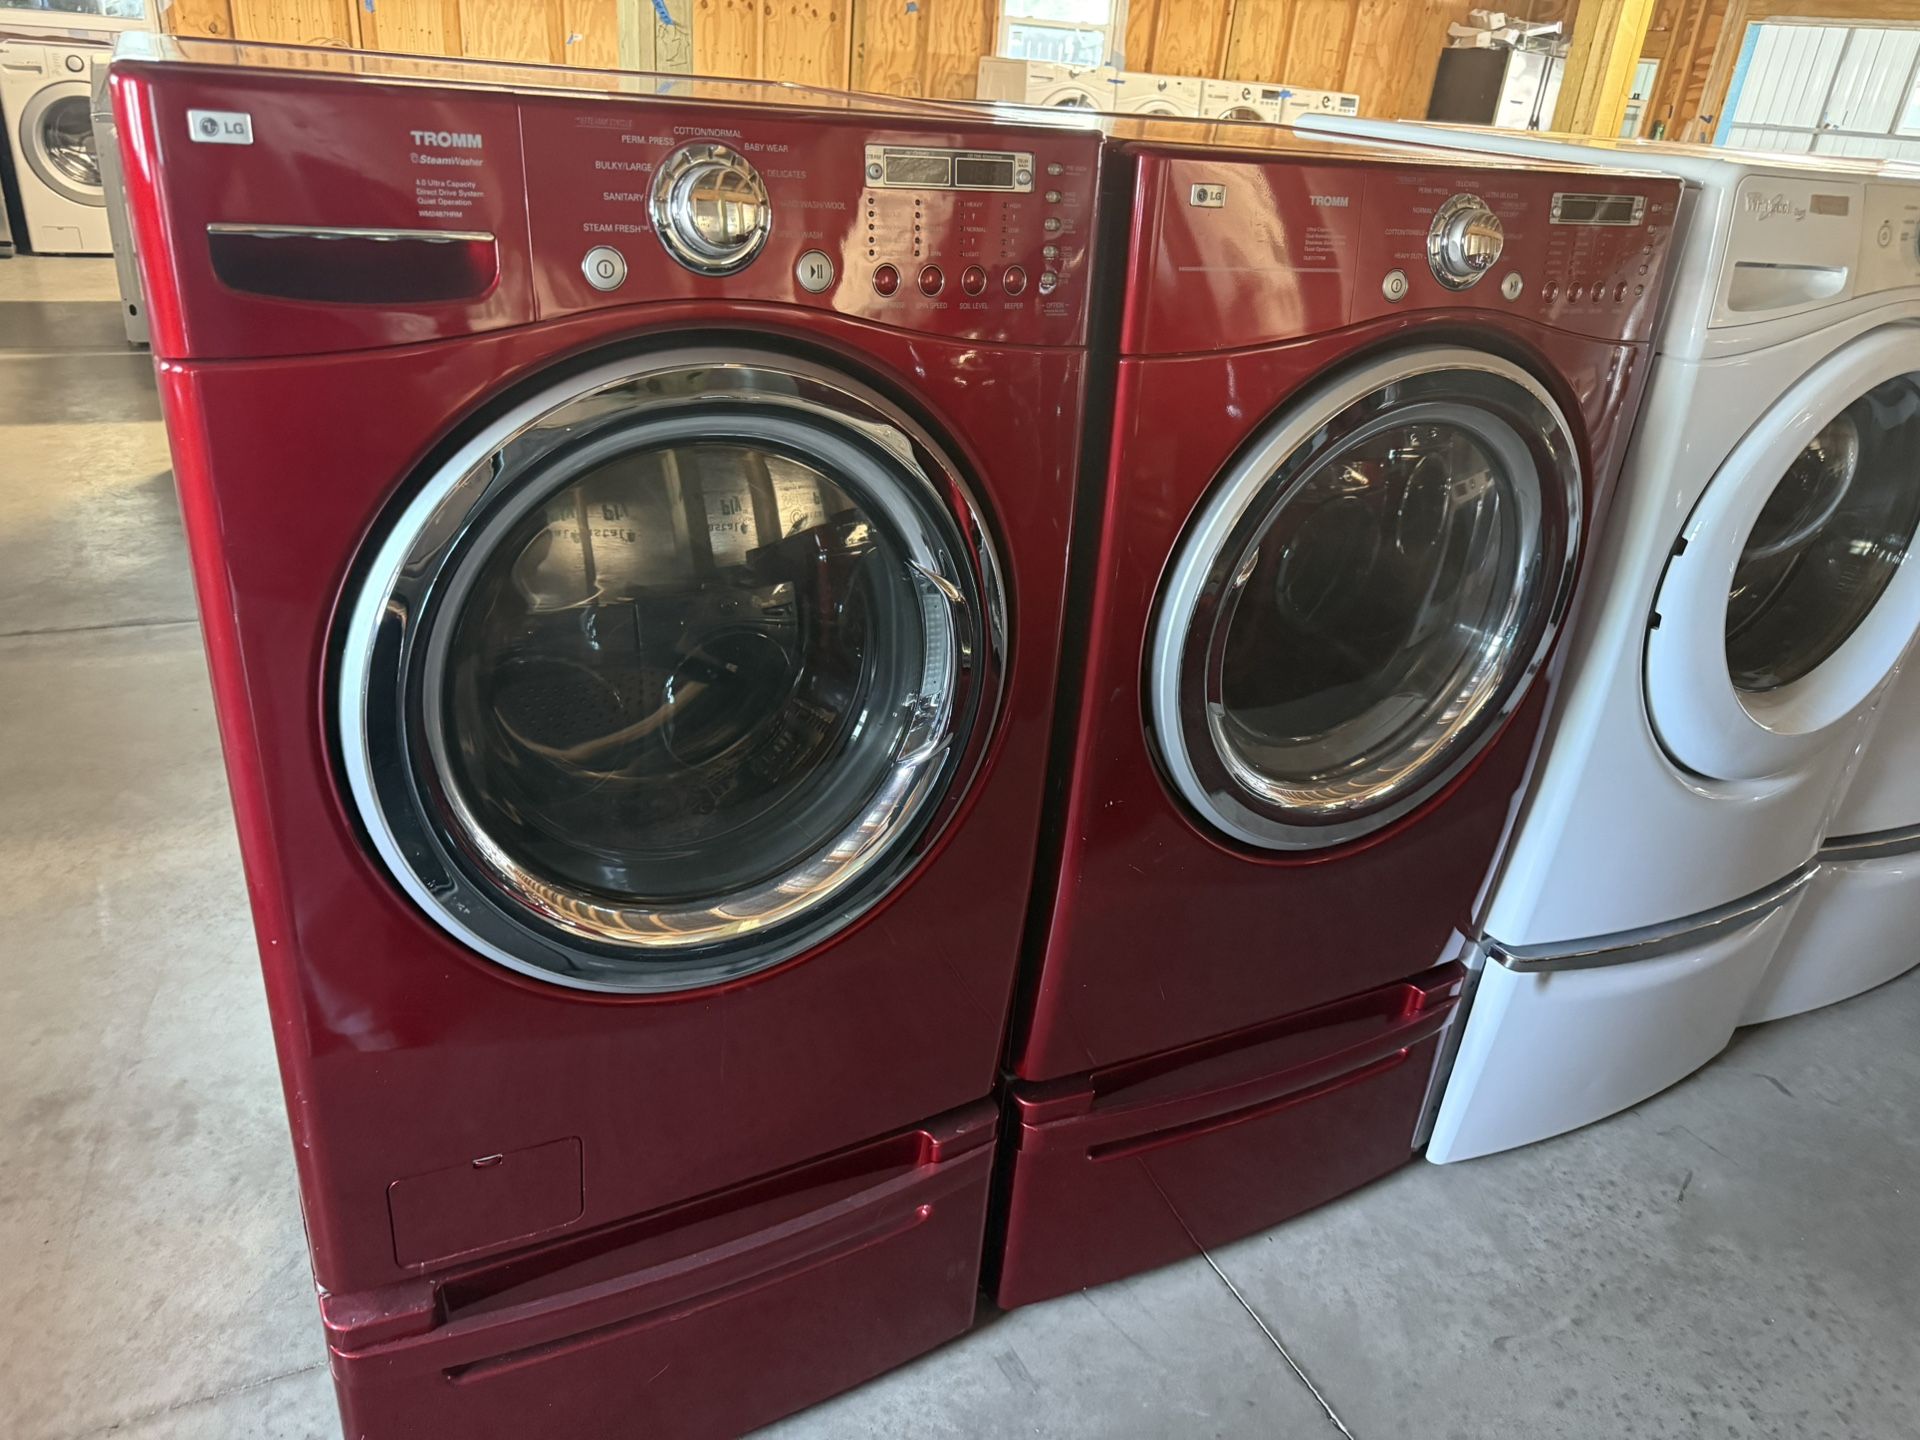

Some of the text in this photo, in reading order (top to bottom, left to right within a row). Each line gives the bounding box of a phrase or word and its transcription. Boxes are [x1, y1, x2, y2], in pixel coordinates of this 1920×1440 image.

[223, 121, 245, 135] LG
[673, 126, 742, 138] COTTON/NORMAL
[410, 130, 482, 148] TROMM
[648, 137, 675, 146] PRESS
[744, 142, 789, 153] BABY WEAR
[420, 154, 484, 167] SteamWasher
[595, 160, 653, 172] BULKY/LARGE
[446, 180, 476, 189] Capacity
[603, 192, 644, 201] SANITARY
[1209, 191, 1222, 201] LG
[1309, 195, 1350, 208] TROMM
[583, 222, 613, 232] STEAM
